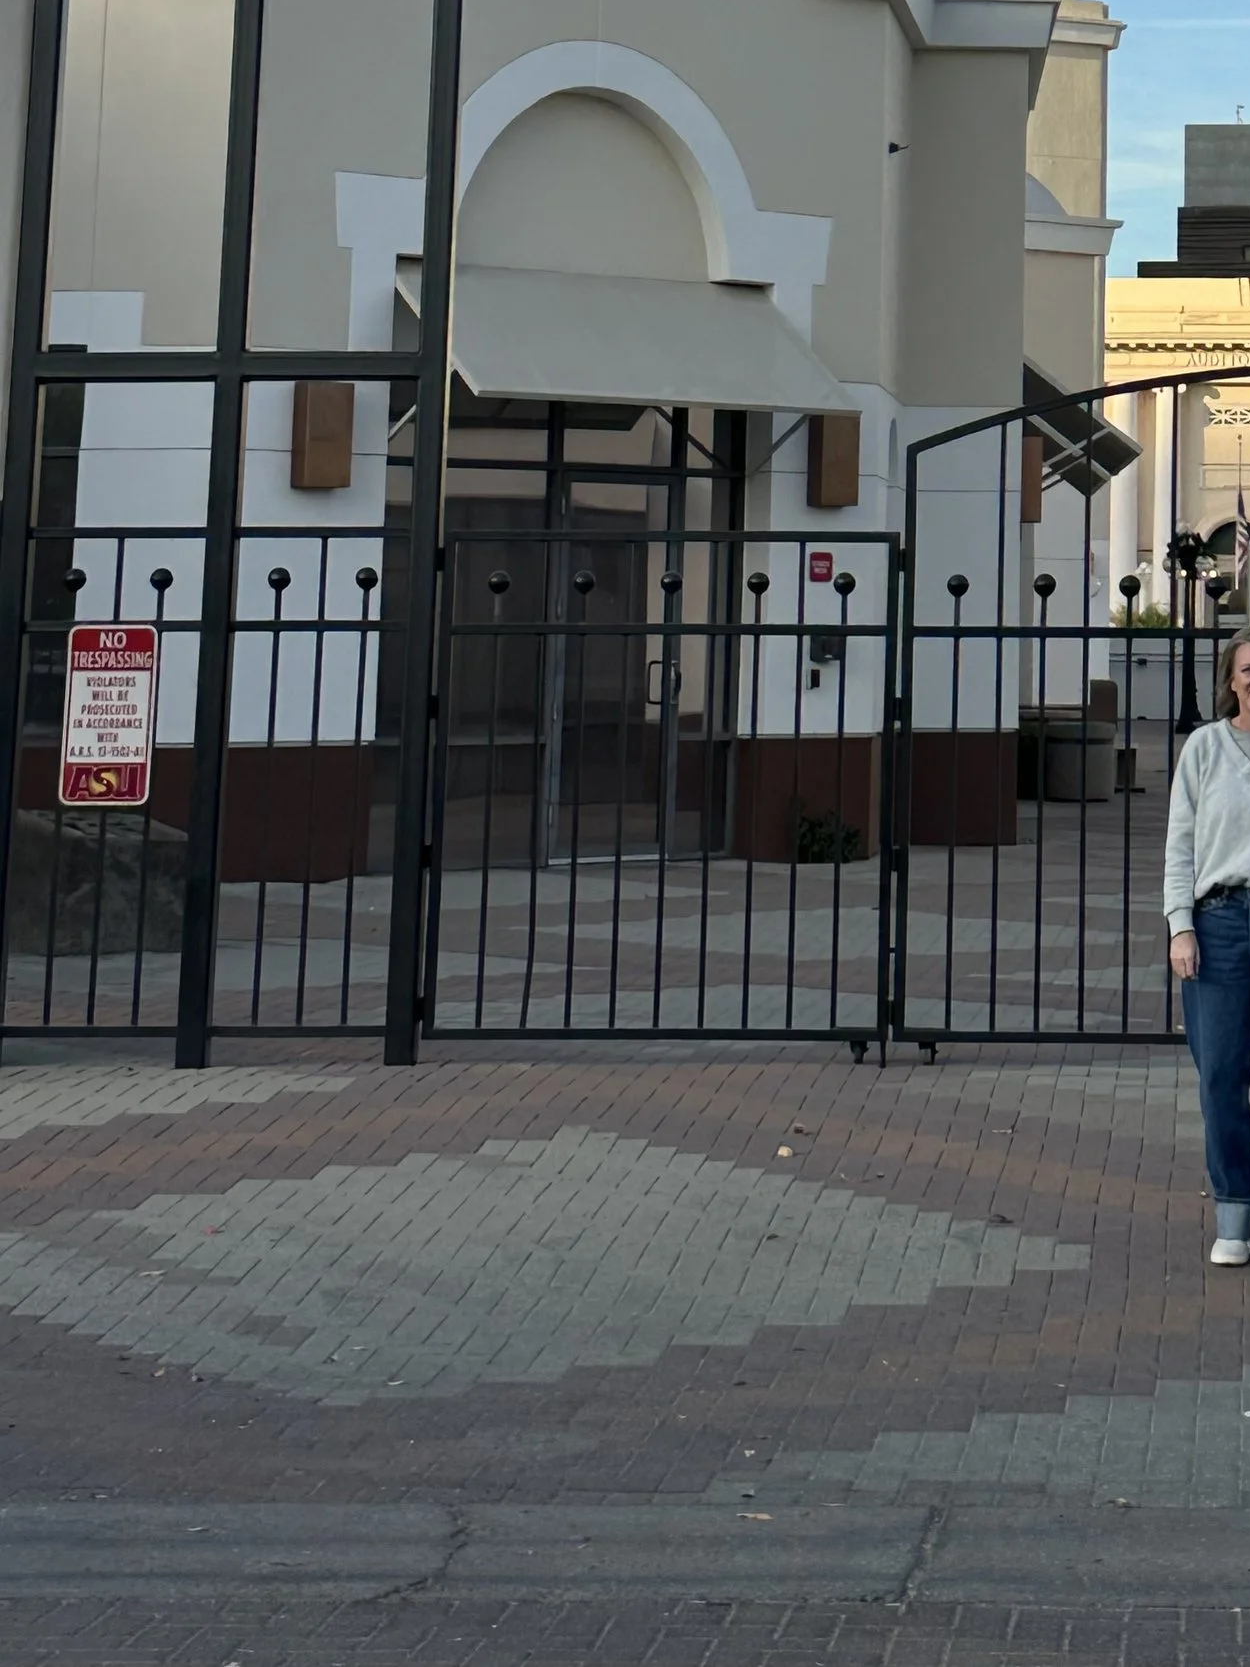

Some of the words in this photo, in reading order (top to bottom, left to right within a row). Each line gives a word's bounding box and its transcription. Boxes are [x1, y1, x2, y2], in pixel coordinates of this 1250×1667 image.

[99, 631, 127, 649] NO
[73, 651, 153, 669] TRESPASSING
[86, 676, 136, 688] VIOLATORS
[92, 690, 114, 702] WILL
[117, 690, 129, 702] BE
[81, 704, 138, 716] PROSECUTED
[73, 718, 83, 729] IN
[86, 718, 143, 730] ACCORDANCE
[66, 765, 141, 800] ASU
